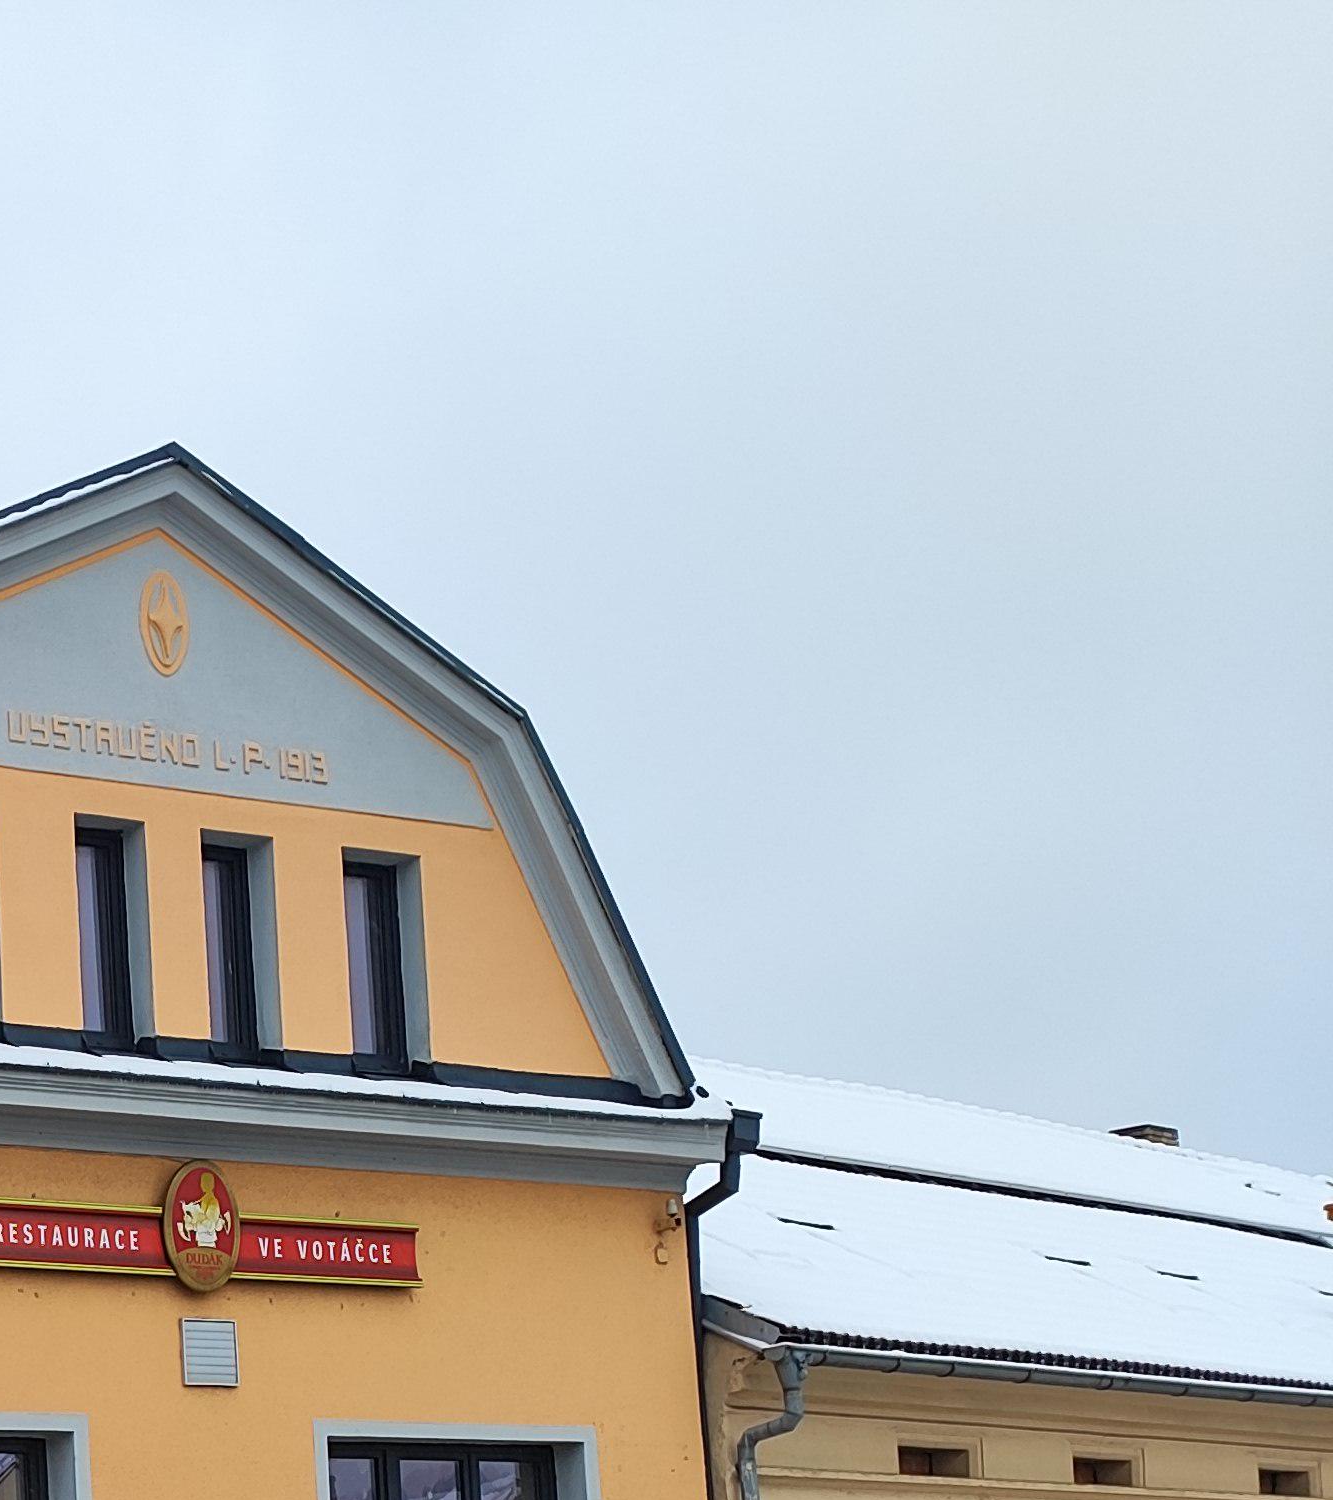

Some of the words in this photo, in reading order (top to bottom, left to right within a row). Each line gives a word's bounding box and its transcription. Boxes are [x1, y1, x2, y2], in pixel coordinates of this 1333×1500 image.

[279, 747, 329, 785] 1913
[186, 1252, 223, 1265] DUDÁK
[258, 1237, 283, 1260] VE
[297, 1236, 393, 1264] VOTÁČCE
